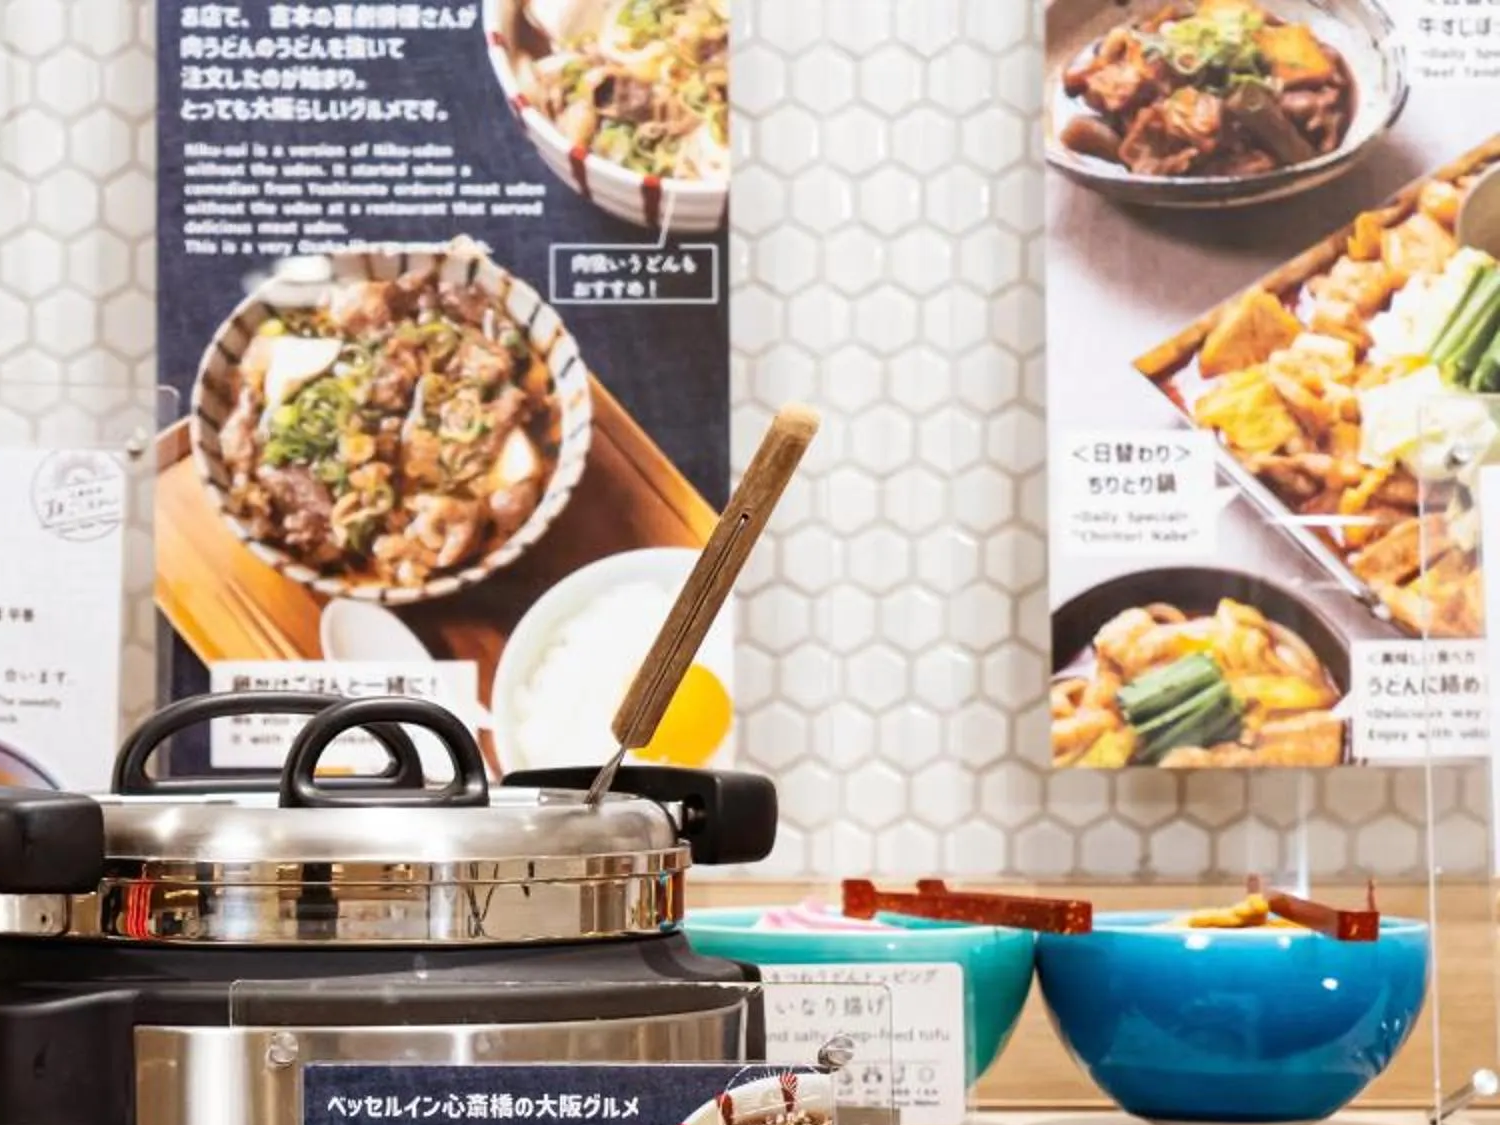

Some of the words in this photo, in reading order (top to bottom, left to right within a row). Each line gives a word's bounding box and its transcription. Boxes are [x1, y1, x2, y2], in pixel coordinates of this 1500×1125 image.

[327, 1093, 640, 1119] ベッセルイン心斎橋の大阪グルメ
